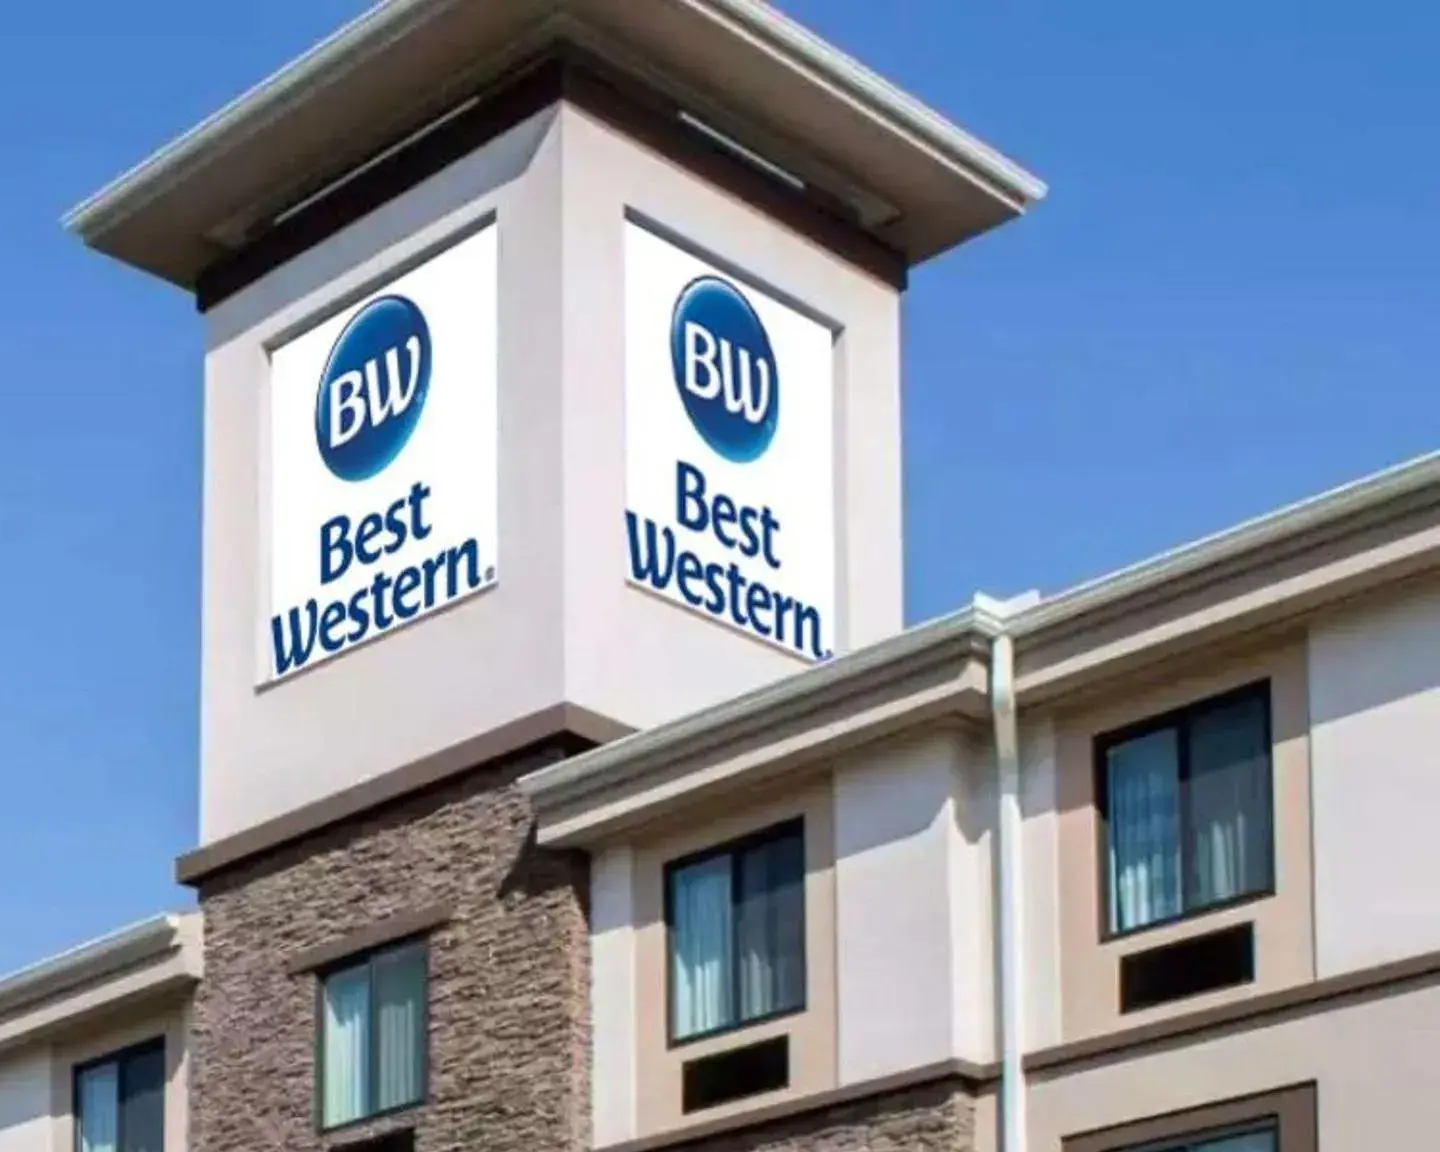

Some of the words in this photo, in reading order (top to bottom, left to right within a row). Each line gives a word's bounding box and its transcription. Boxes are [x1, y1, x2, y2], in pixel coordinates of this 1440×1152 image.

[329, 335, 421, 449] BW
[684, 320, 771, 425] BW
[320, 482, 432, 586] Best
[676, 459, 781, 569] Best
